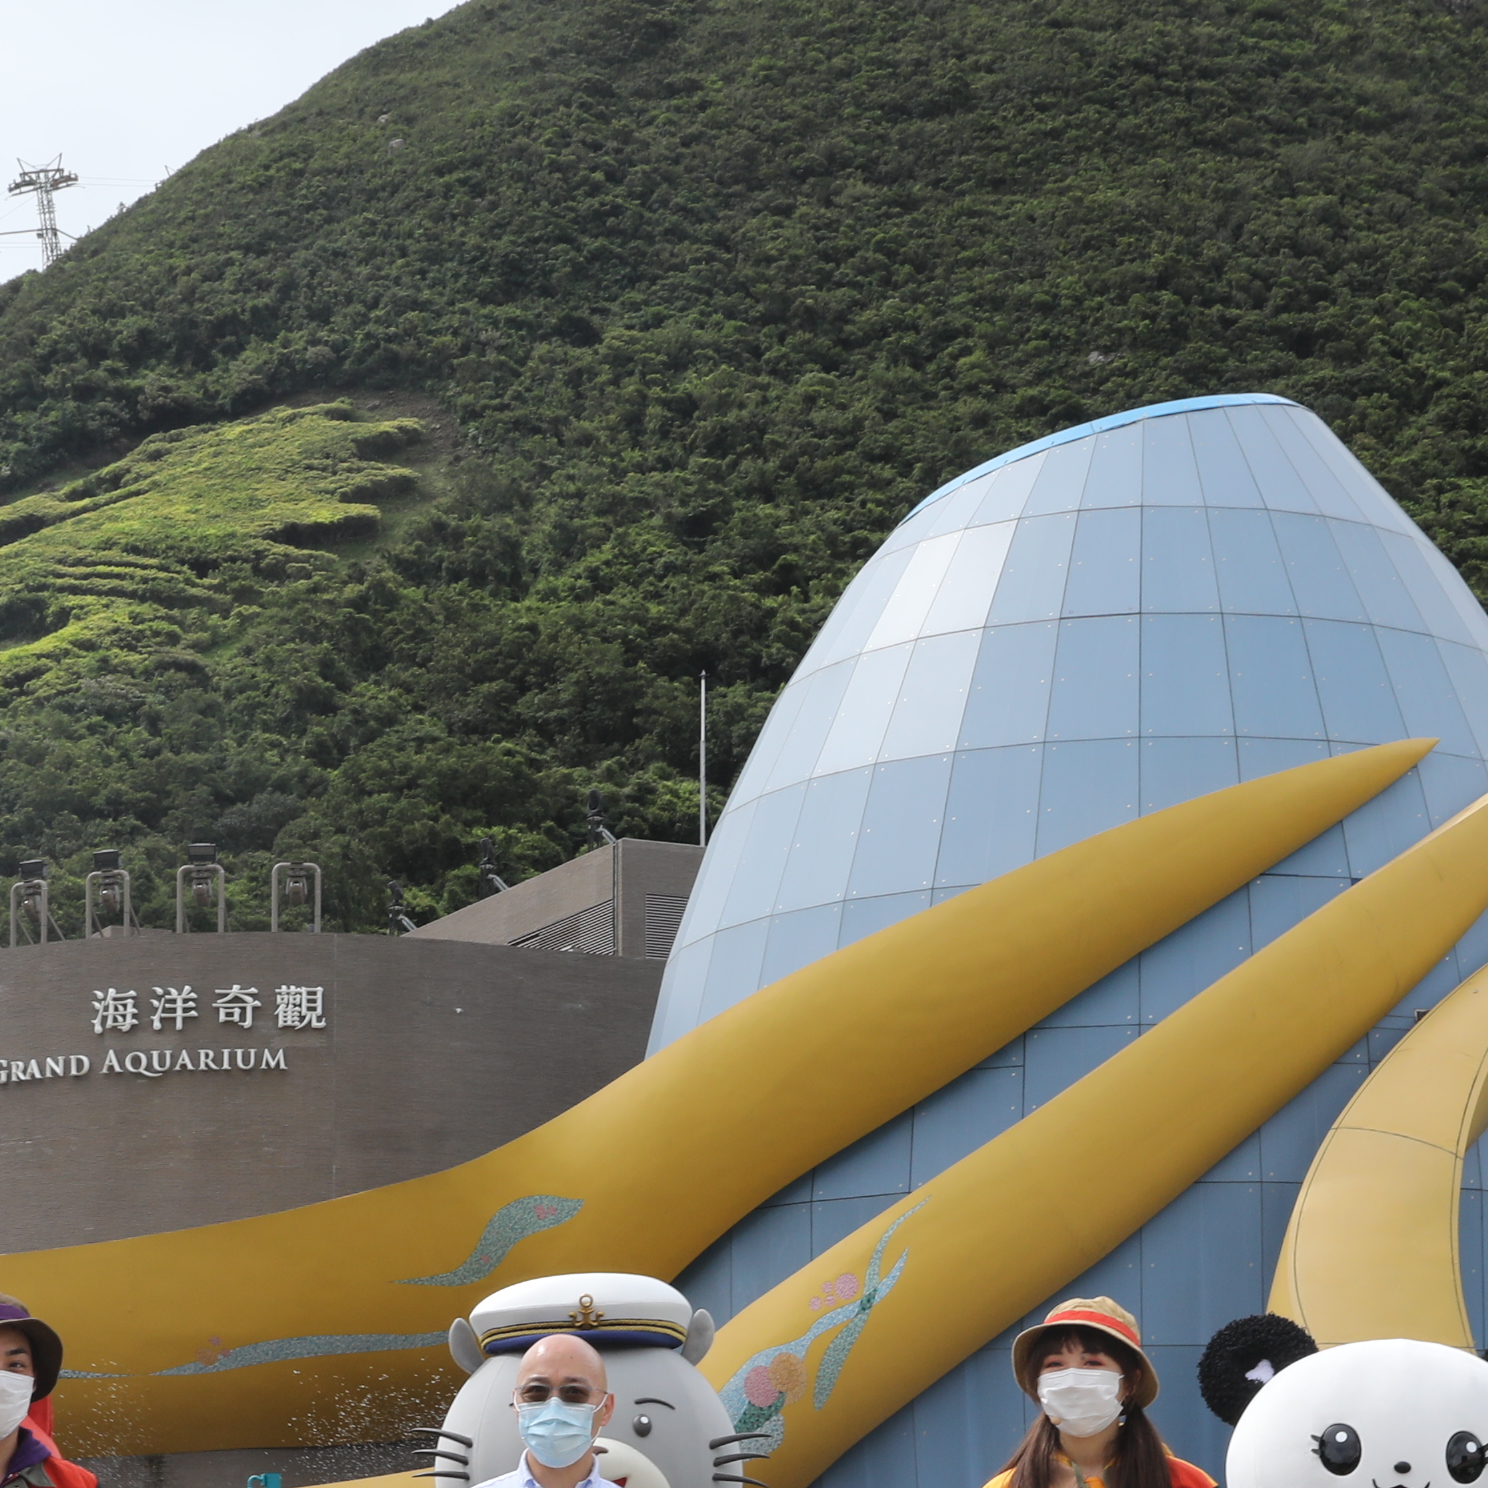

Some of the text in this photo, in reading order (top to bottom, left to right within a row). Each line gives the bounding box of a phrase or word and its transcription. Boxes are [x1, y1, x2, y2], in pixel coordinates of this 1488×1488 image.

[91, 984, 327, 1034] 海洋奇觀
[99, 1047, 289, 1078] AQUARIUM
